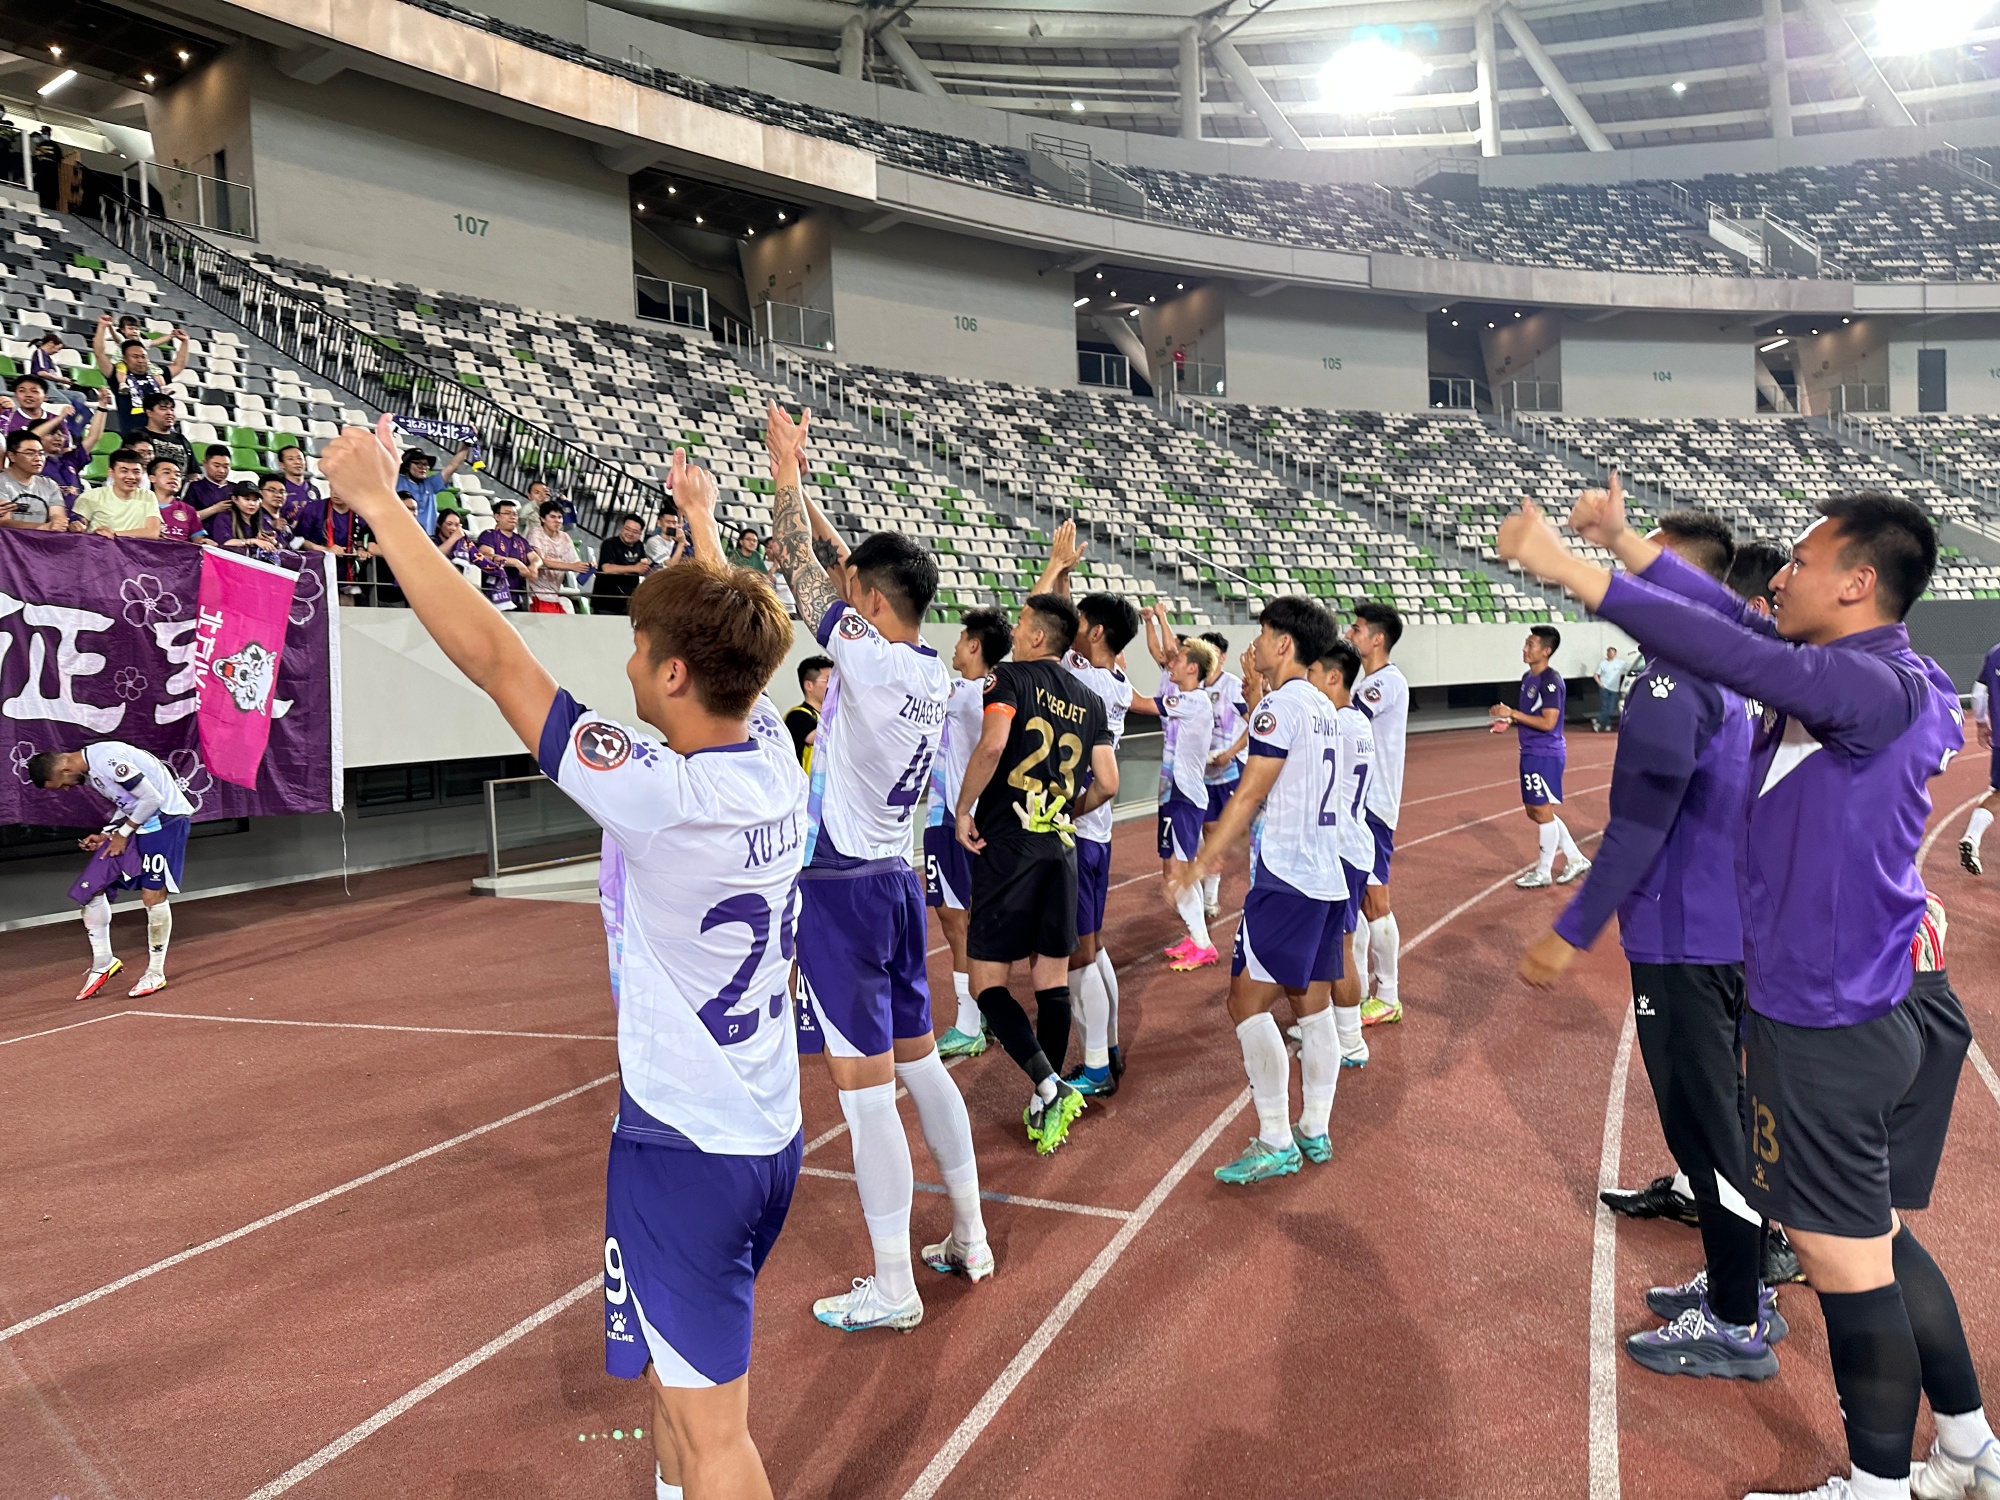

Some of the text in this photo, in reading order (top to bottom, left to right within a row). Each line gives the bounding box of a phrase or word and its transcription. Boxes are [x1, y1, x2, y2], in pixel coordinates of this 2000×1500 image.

[452, 213, 489, 237] 107
[954, 315, 978, 332] 106
[1322, 356, 1342, 370] 105
[1652, 371, 1672, 382] 104
[899, 694, 932, 725] ZHAO
[1007, 716, 1083, 800] 23
[886, 735, 932, 823] 4
[1318, 747, 1337, 827] 2
[1523, 773, 1542, 791] 33
[1162, 817, 1172, 838] 7
[744, 826, 772, 869] XU
[142, 853, 165, 874] 40
[926, 854, 938, 880] 5
[796, 965, 809, 1009] 4
[604, 1236, 628, 1306] 9
[606, 1330, 635, 1343] KELME
